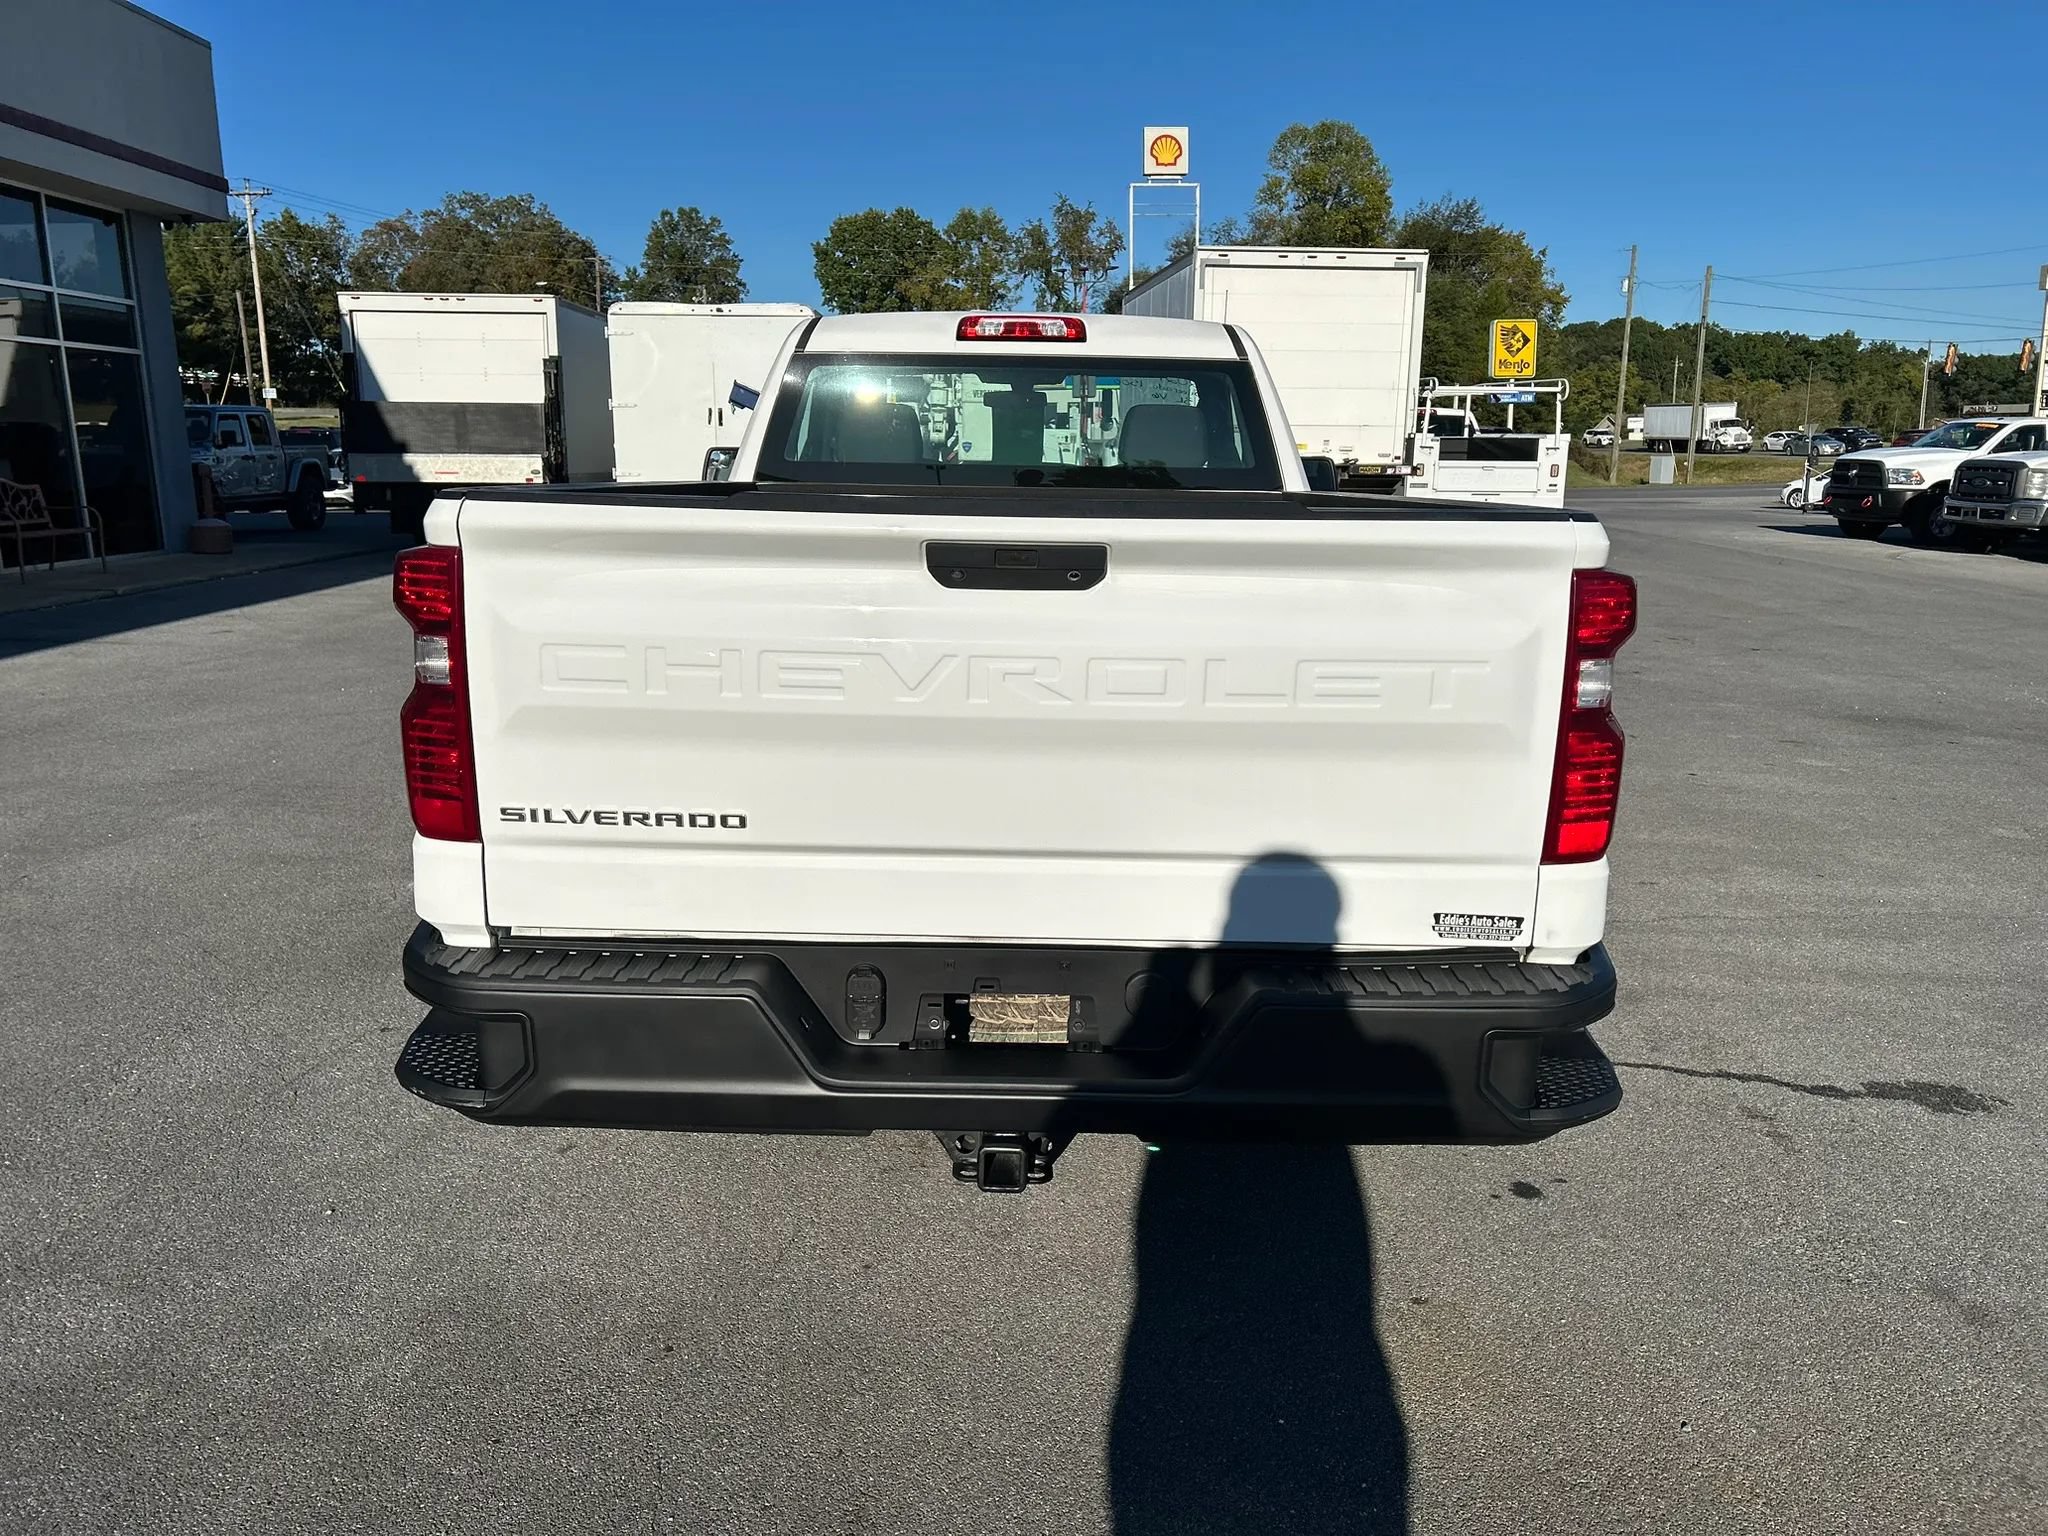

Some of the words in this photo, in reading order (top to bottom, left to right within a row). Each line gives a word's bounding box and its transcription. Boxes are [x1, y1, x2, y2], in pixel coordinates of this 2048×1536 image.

[1520, 394, 1534, 403] ATM
[540, 643, 1492, 710] CHEVROLET
[499, 807, 748, 829] SILVERADO
[1440, 913, 1470, 927] Eddie's
[1470, 915, 1493, 928] Auto
[1493, 916, 1518, 929] Sales
